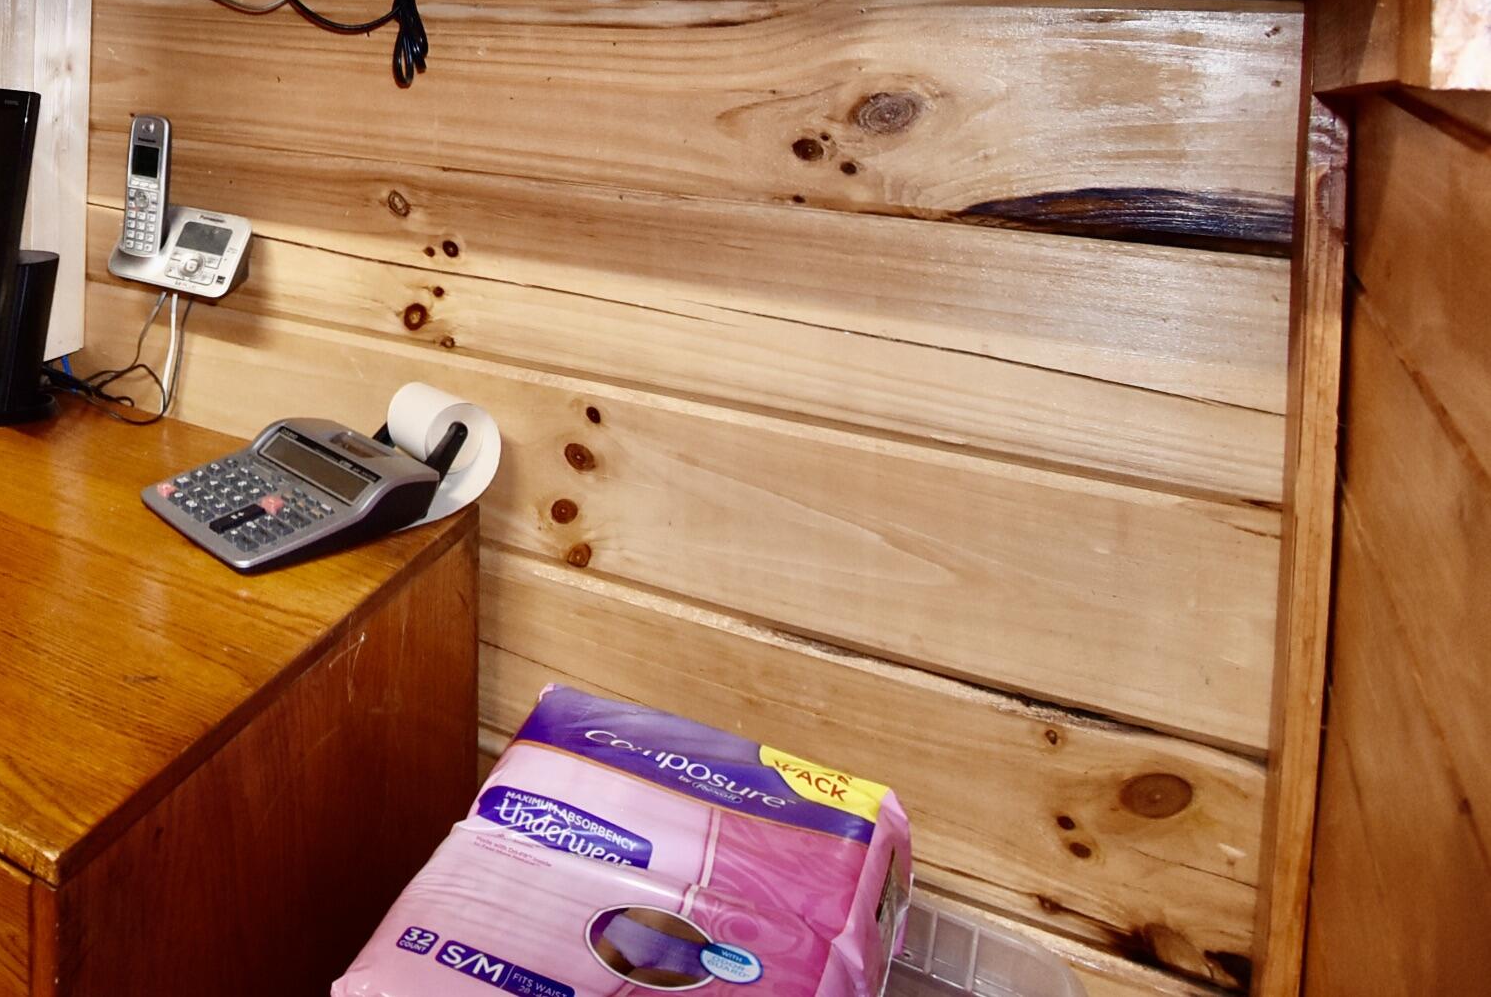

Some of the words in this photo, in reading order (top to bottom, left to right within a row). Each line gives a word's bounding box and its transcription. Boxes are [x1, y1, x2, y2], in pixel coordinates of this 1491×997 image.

[505, 791, 559, 815] MAXIMUM
[558, 808, 638, 852] ABSORBENCY
[399, 939, 428, 953] COUNT
[404, 927, 436, 947] 32
[441, 944, 505, 983] S/M
[721, 949, 743, 962] WITH
[512, 972, 534, 988] FITS
